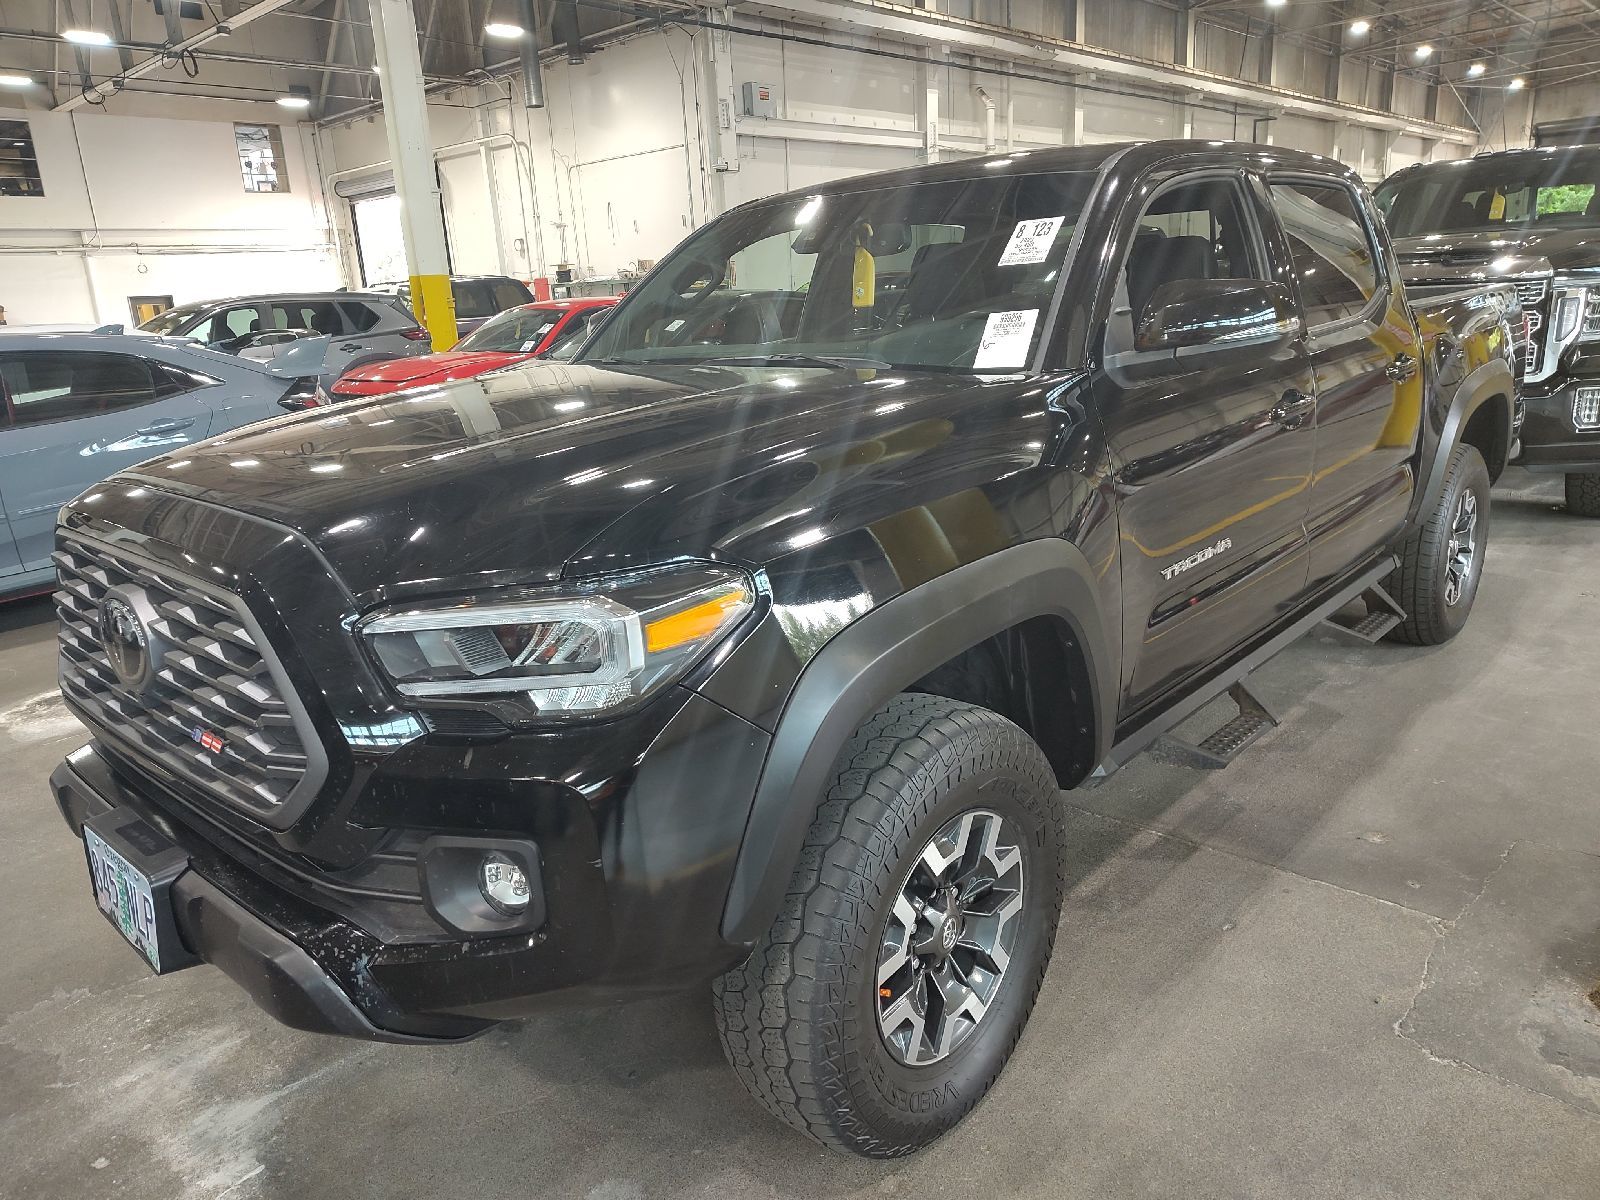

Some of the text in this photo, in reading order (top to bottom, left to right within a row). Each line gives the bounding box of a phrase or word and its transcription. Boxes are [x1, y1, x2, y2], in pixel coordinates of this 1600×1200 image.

[1016, 221, 1054, 238] 8 123
[1160, 537, 1232, 580] TACOMA
[104, 844, 130, 876] Oregon
[91, 849, 154, 941] 845 NLP
